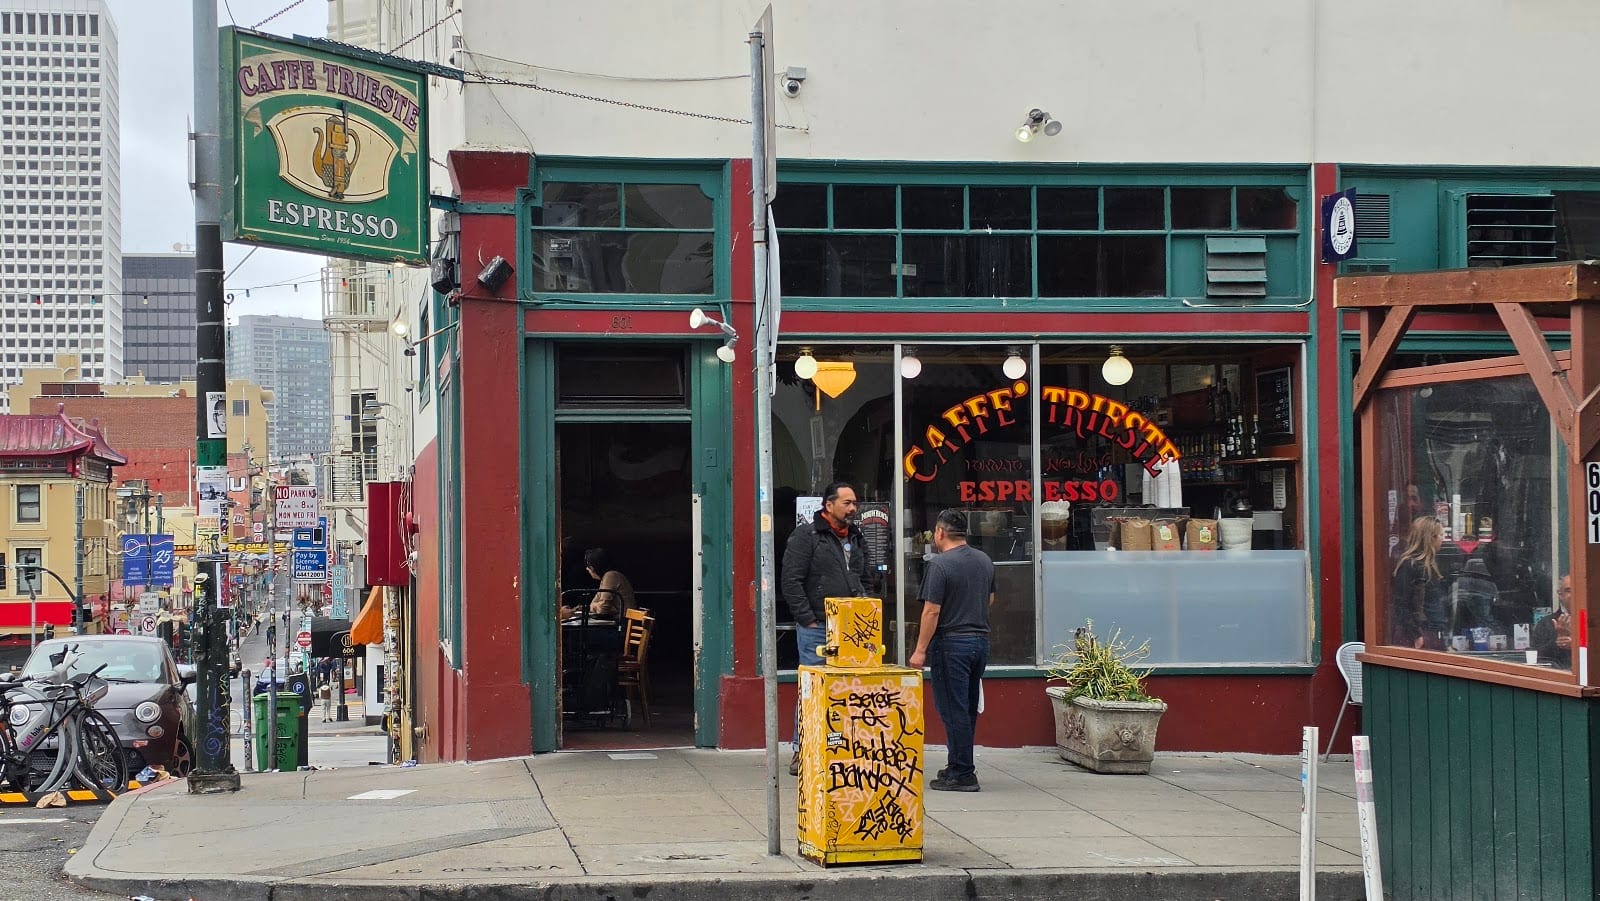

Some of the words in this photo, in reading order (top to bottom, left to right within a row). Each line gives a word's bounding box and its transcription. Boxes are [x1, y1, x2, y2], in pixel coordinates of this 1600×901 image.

[238, 60, 317, 97] CAFFE
[322, 62, 421, 133] TRIESTE
[267, 199, 398, 240] ESPRESSO
[1041, 386, 1182, 479] TRIESTE
[276, 487, 289, 498] NO
[960, 480, 1118, 503] ESPRESSO
[154, 549, 172, 564] 25
[21, 734, 34, 747] lyft
[30, 724, 45, 737] bike
